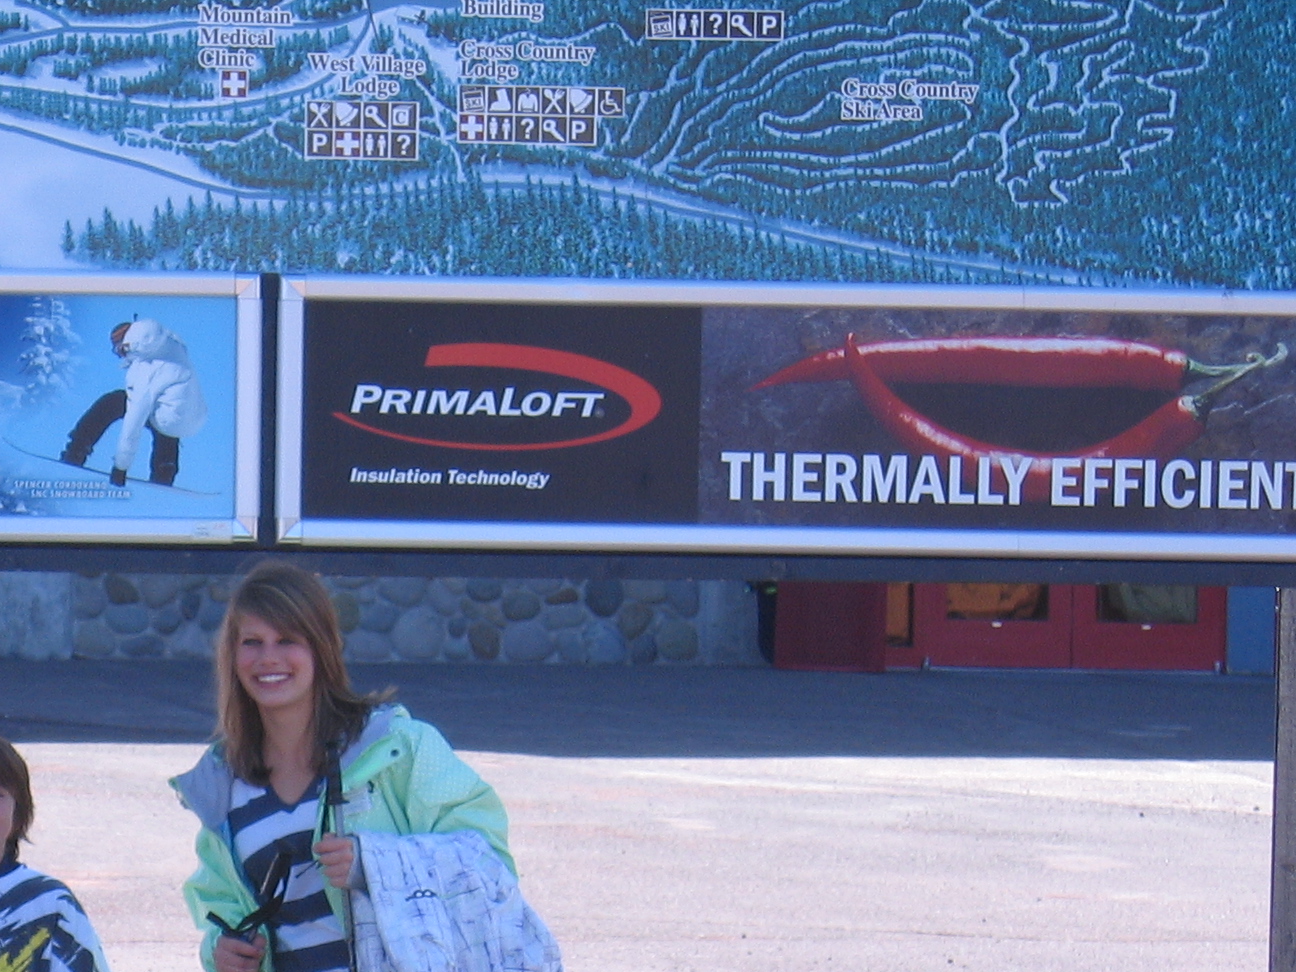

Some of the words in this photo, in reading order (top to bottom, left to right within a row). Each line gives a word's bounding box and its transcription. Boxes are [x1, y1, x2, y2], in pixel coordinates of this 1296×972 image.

[200, 6, 292, 25] Mountain
[463, 0, 543, 21] Building
[199, 28, 274, 46] Medical
[199, 49, 255, 67] Clinic
[461, 40, 512, 59] Cross
[517, 42, 595, 65] Country
[309, 54, 356, 71] West
[361, 55, 425, 75] Village
[461, 60, 517, 82] Lodge
[340, 76, 399, 98] Lodge
[842, 78, 895, 98] Cross
[899, 79, 979, 103] Country
[842, 101, 872, 119] Ski
[876, 100, 922, 119] Area
[349, 467, 442, 484] Insulation
[447, 468, 550, 489] Technology
[721, 451, 1032, 506] THERMALLY
